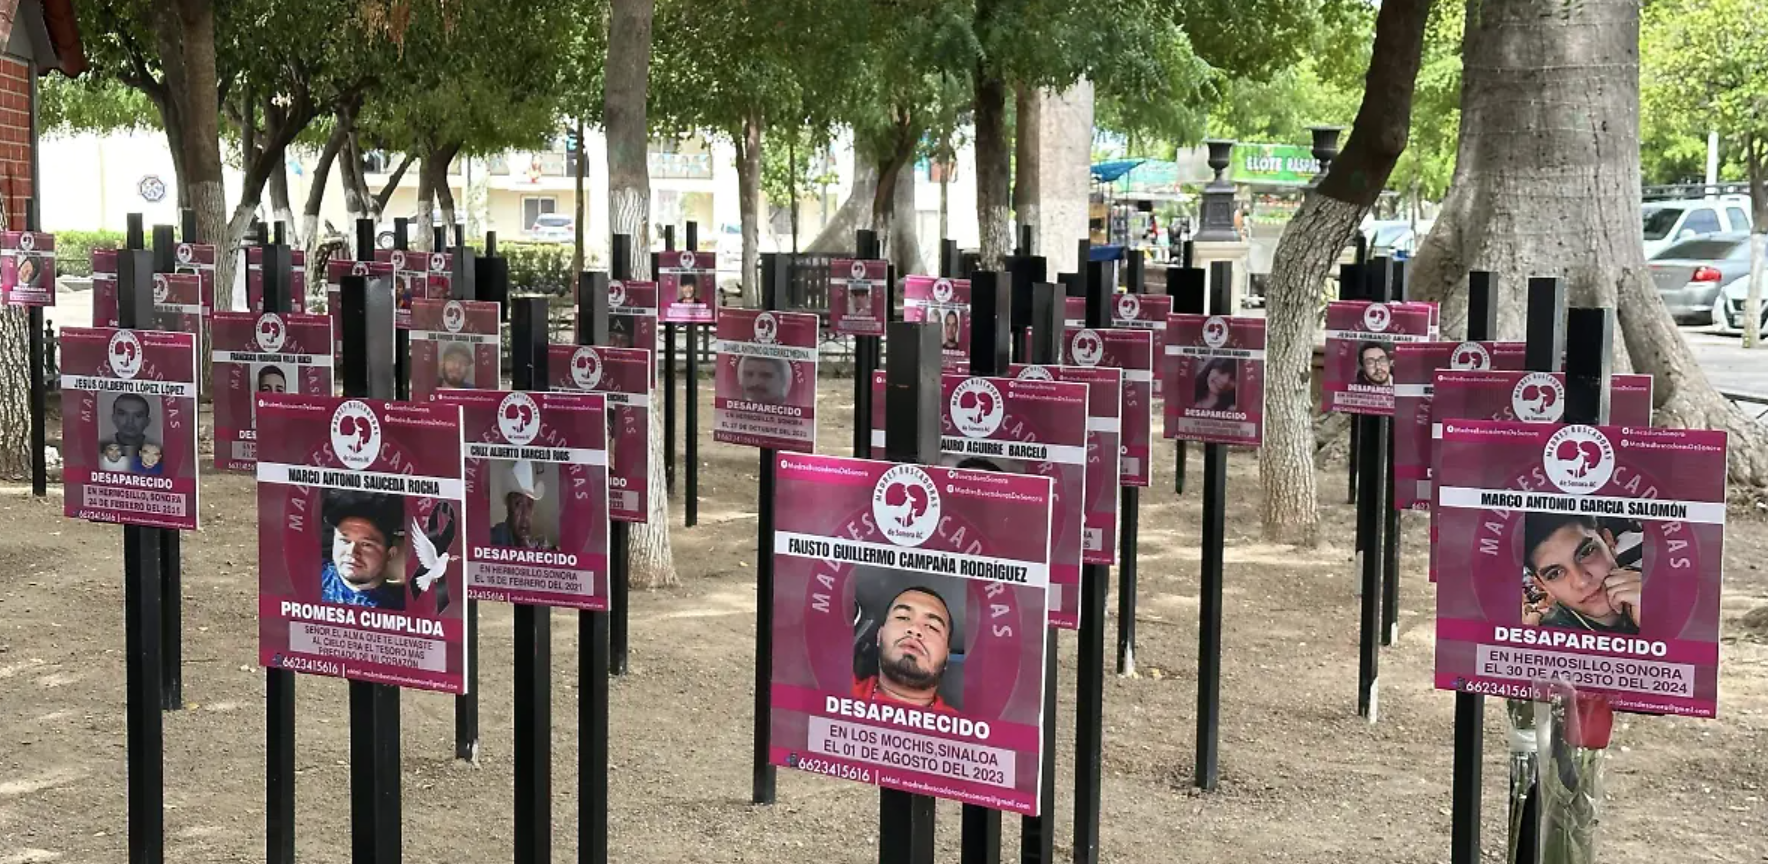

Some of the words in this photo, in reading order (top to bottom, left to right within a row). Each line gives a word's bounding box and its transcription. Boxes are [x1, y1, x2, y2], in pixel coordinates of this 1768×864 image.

[1246, 155, 1282, 171] ELOTE
[98, 379, 133, 392] GILBERTO
[727, 400, 801, 416] DESAPARECIDO
[1185, 408, 1247, 420] DESAPARECIDO
[470, 445, 488, 456] CRUZ
[489, 446, 519, 459] ALBERTO
[940, 439, 964, 452] AURO
[966, 441, 1003, 455] AGUIRRE
[1008, 444, 1047, 460] BARCELÓ
[1545, 429, 1570, 457] MADRES
[1570, 426, 1612, 460] BUSCADORAS
[91, 471, 173, 489] DESAPARECIDO
[288, 468, 320, 484] MARCO
[322, 470, 361, 488] ANTONIO
[363, 474, 406, 492] SAUCEDA
[408, 478, 440, 496] ROCHA
[875, 469, 897, 502] MADRES
[898, 466, 938, 508] BUSCADORAS
[87, 487, 98, 496] EN
[150, 493, 182, 504] SONORA
[100, 499, 109, 508] DE
[147, 502, 161, 513] DEL
[1480, 493, 1522, 507] MARCO
[1525, 496, 1576, 511] ANTONIO
[1579, 499, 1624, 514] GARCIA
[1628, 501, 1687, 518] SALOMÓN
[887, 528, 895, 537] de
[895, 528, 915, 539] Sonora
[915, 531, 923, 539] AC
[474, 547, 578, 566] DESAPARECIDO
[788, 538, 830, 558] FAUSTO
[833, 543, 896, 567] GUILLERMO
[899, 549, 956, 574] CAMPAÑA
[960, 556, 1028, 583] RODRÍGUEZ
[479, 563, 491, 574] EN
[474, 574, 485, 584] EL
[497, 577, 507, 587] DE
[509, 578, 546, 590] FEBRERO
[548, 581, 563, 591] DEL
[565, 582, 583, 593] 2021
[281, 601, 356, 625] PROMESA
[360, 611, 445, 637] CUMPLIDA
[312, 637, 322, 645] AL
[323, 638, 346, 649] CIELO
[347, 641, 363, 651] ERA
[365, 644, 374, 653] EL
[376, 645, 406, 657] TESORO
[343, 630, 365, 641] ALMA
[366, 633, 382, 644] QUE
[384, 635, 393, 645] TE
[395, 637, 433, 651] LLEVASTE
[1494, 626, 1668, 657] DESAPARECIDO
[318, 647, 357, 660] PRECIADO
[359, 652, 369, 661] DE
[1490, 650, 1509, 662] EN
[282, 656, 338, 675] 6623415616
[1484, 663, 1502, 674] EL
[1506, 665, 1523, 677] 30
[1527, 667, 1547, 679] DE
[1551, 669, 1614, 686] AGOSTO
[1618, 676, 1649, 690] DEL
[1653, 680, 1688, 694] 2024
[1466, 680, 1541, 699] 6623415616
[826, 695, 990, 739] DESAPARECIDO
[830, 724, 848, 740] EN
[851, 728, 877, 744] LOS
[798, 756, 870, 783] 6623415616
[823, 739, 841, 753] EL
[843, 742, 857, 757] 01
[861, 745, 879, 760] DE
[882, 750, 938, 772] AGOSTO
[942, 760, 969, 778] DEL
[972, 764, 1005, 784] 2023
